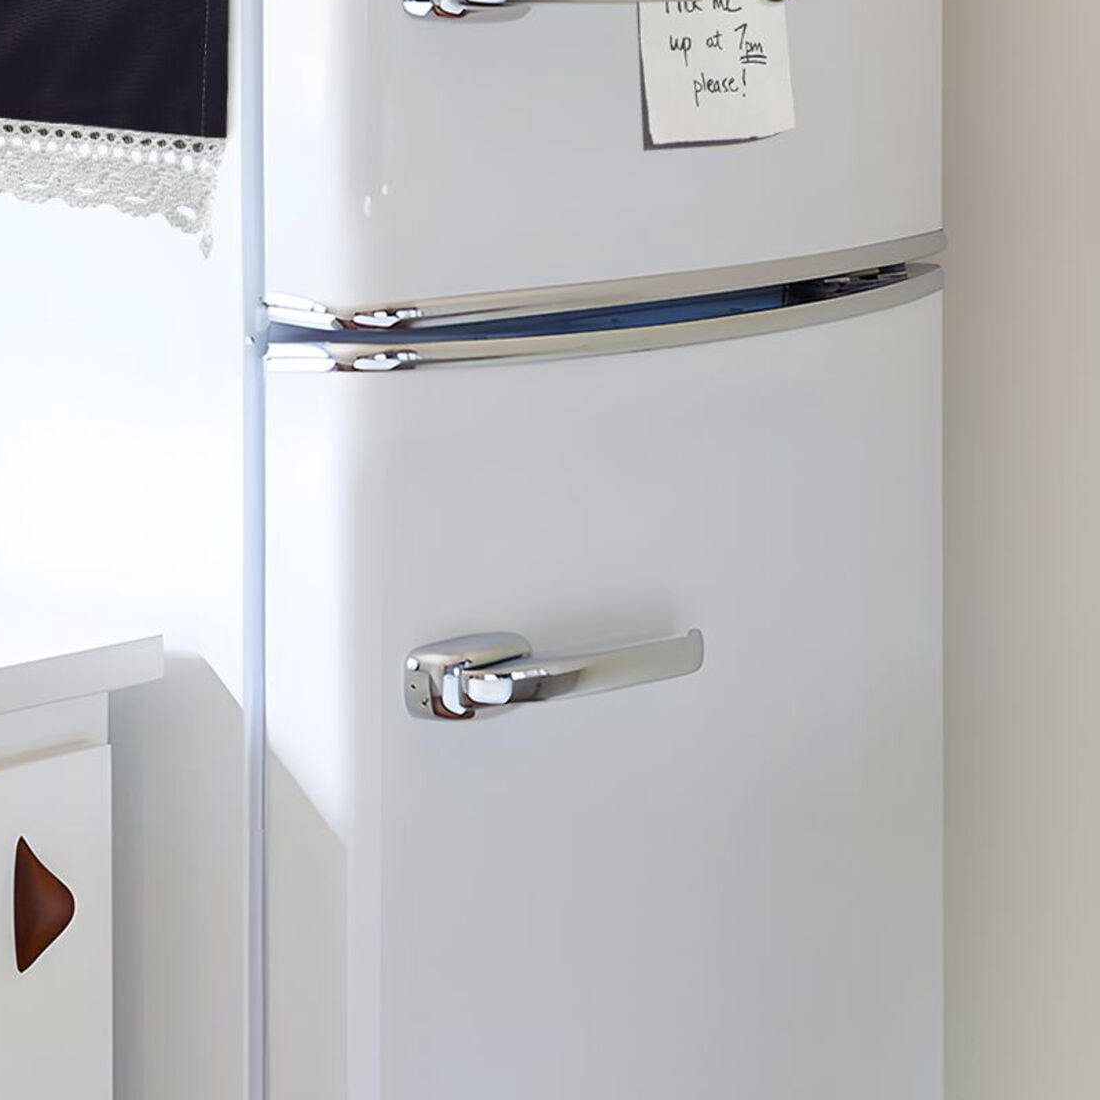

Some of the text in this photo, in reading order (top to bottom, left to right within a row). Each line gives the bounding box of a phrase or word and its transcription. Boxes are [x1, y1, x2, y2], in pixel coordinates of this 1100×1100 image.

[669, 35, 693, 67] up
[705, 29, 723, 51] at
[693, 68, 747, 107] please!
